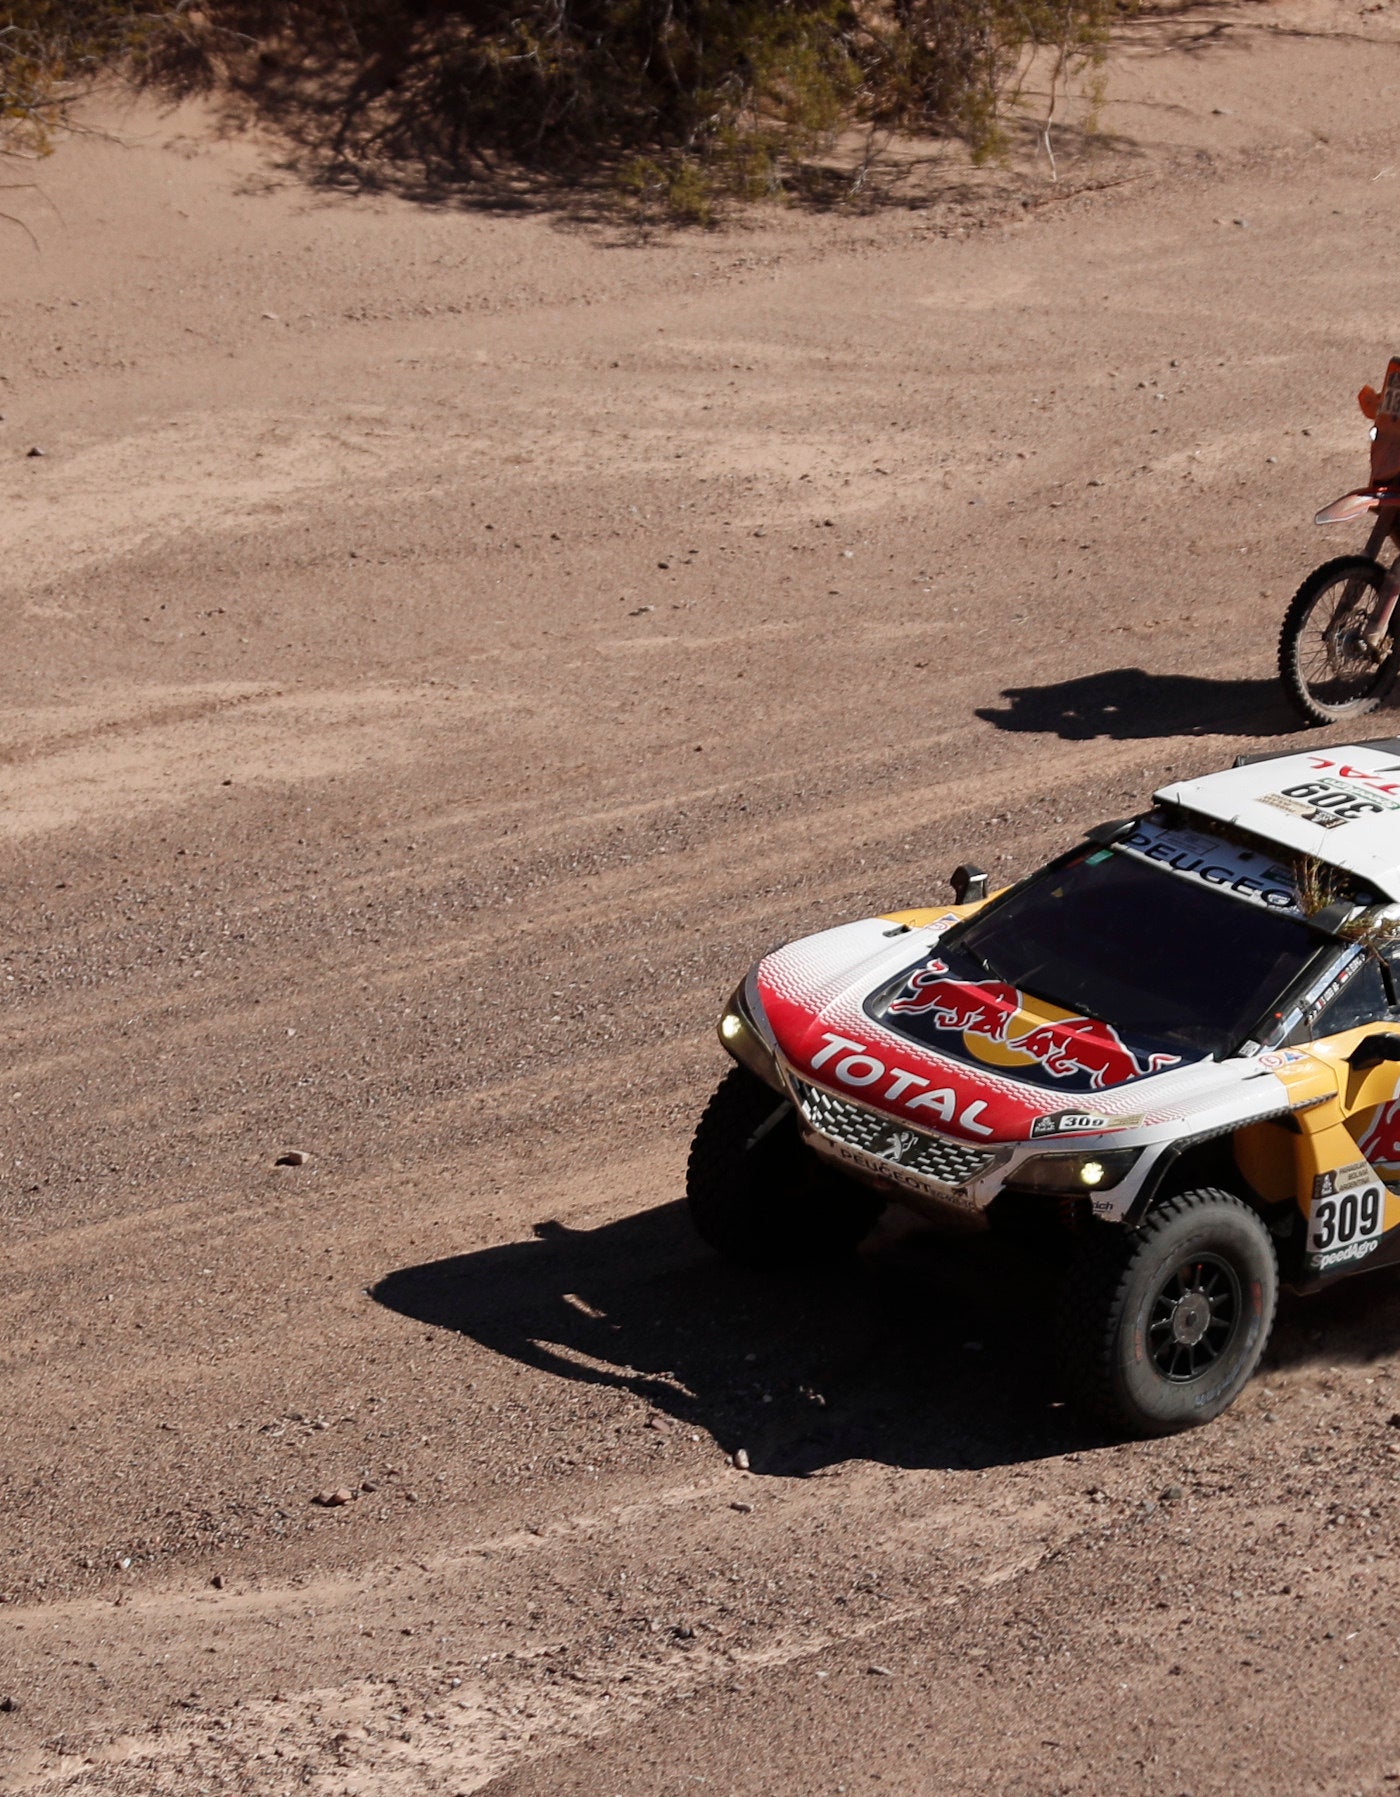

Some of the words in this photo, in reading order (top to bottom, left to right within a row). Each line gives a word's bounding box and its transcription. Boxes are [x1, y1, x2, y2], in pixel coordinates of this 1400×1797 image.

[1281, 782, 1384, 819] 309
[810, 1032, 994, 1136] TOTAL
[1313, 1186, 1379, 1249] 309
[1310, 1240, 1378, 1270] SpeedAgro
